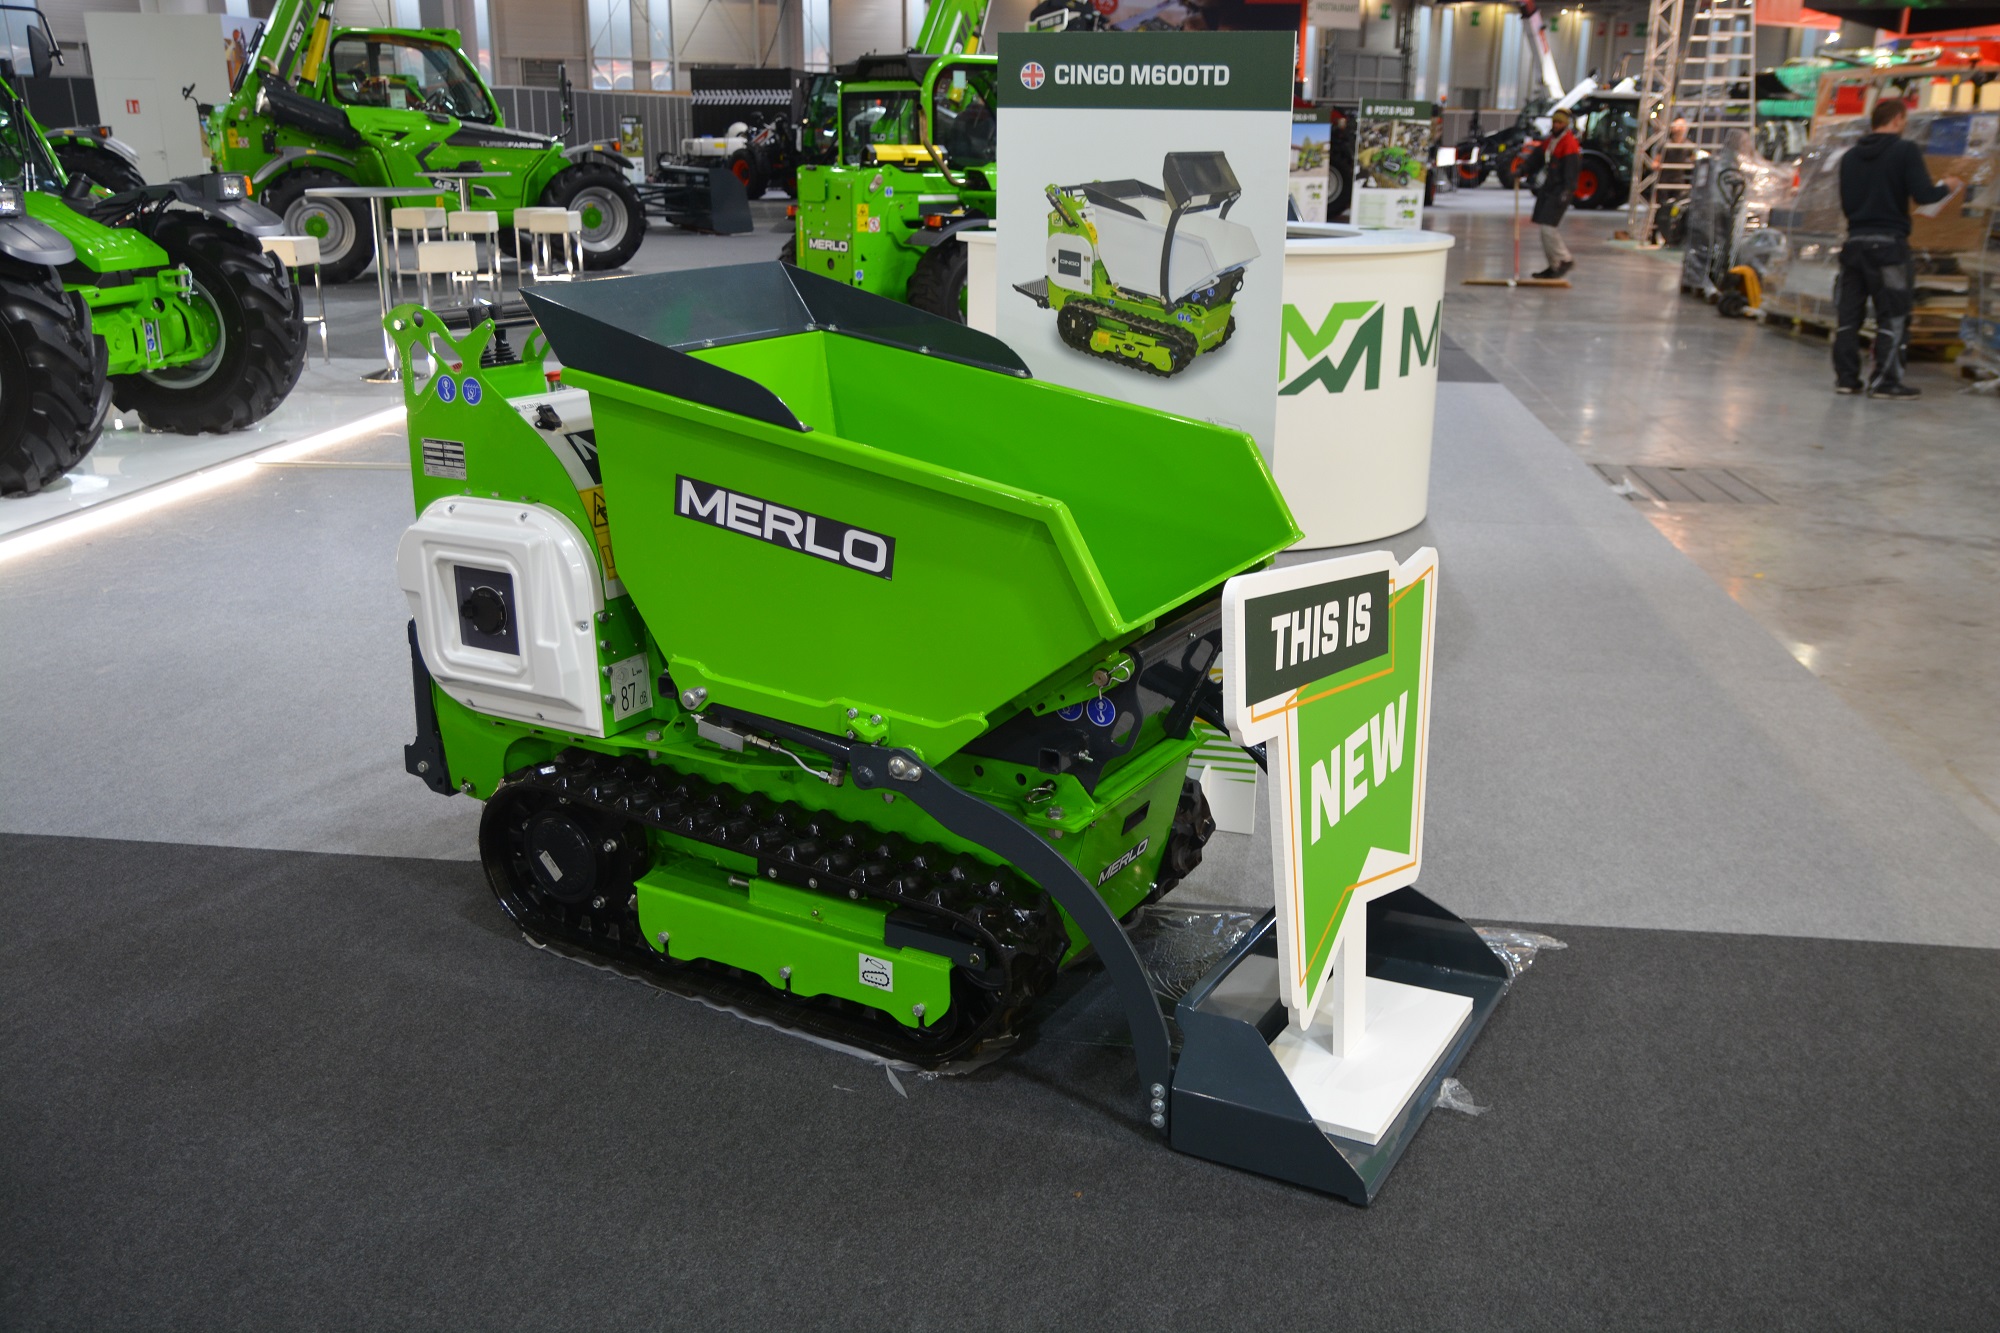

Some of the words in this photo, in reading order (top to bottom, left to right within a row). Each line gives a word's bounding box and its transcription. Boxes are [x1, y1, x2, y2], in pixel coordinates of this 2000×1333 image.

[1054, 64, 1125, 85] CINGO
[1130, 65, 1230, 86] M600TD
[479, 140, 543, 149] TURBOFARMER
[809, 238, 848, 252] MERLO
[1060, 258, 1080, 267] CINGO
[680, 479, 888, 573] MERLO
[1271, 600, 1340, 671] THIS
[1346, 591, 1372, 648] IS
[621, 682, 636, 711] 87
[639, 690, 648, 705] dB
[1311, 689, 1408, 846] NEW
[1098, 838, 1149, 886] MERLO
